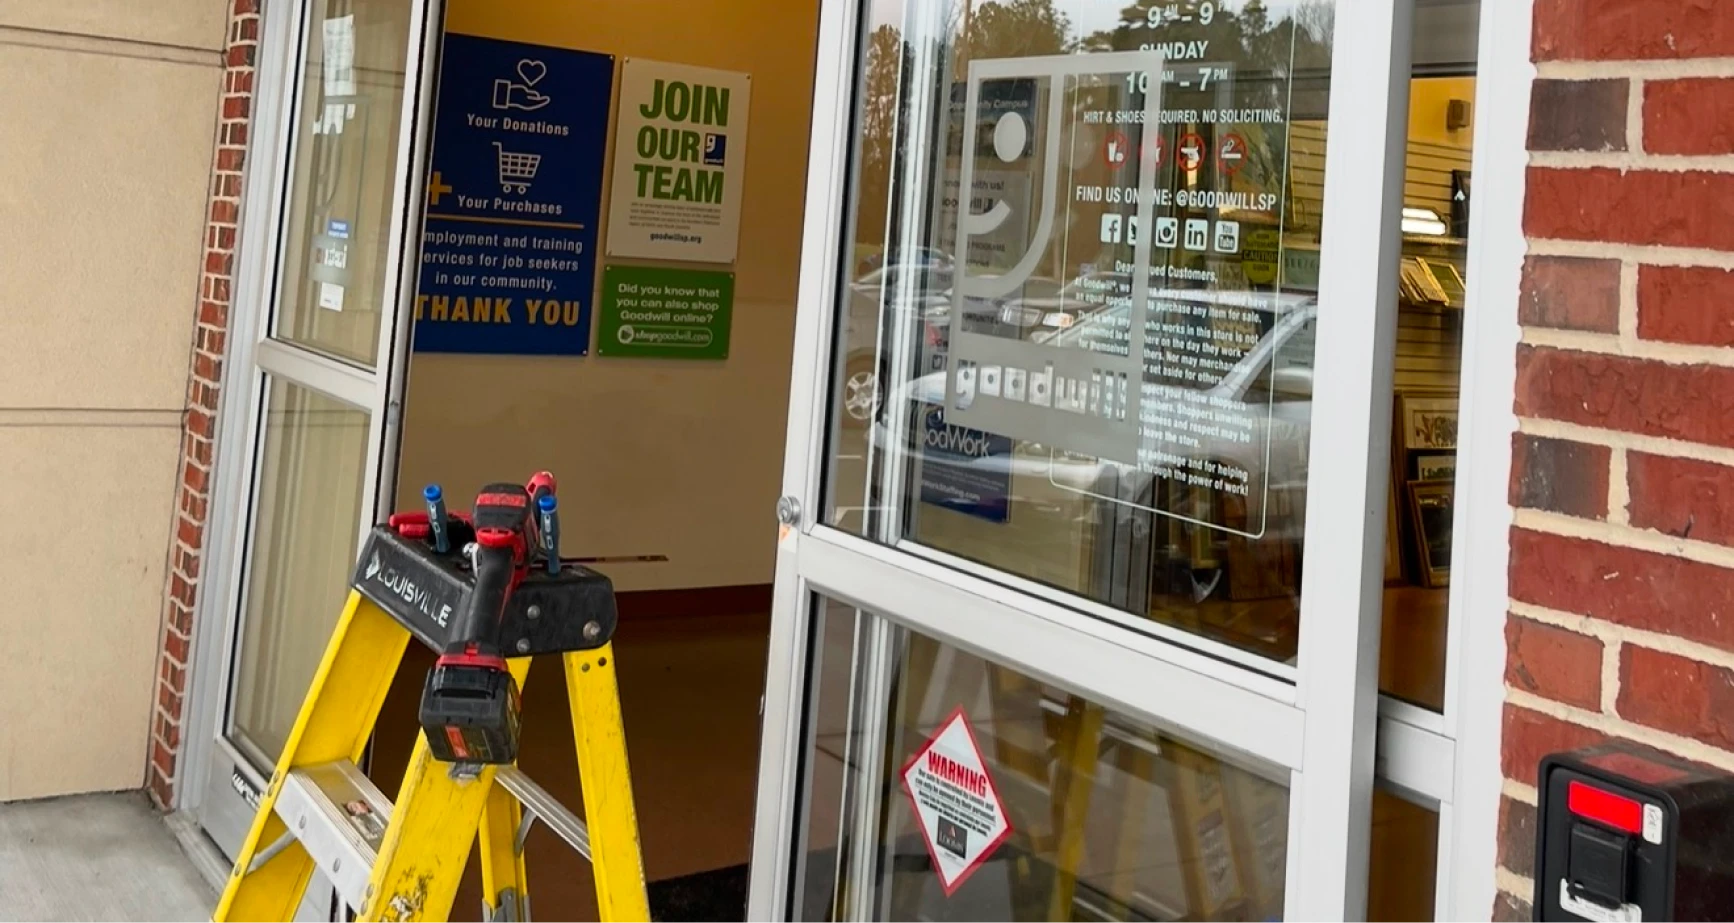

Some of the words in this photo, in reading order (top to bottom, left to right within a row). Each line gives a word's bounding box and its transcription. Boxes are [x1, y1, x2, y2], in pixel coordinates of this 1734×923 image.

[1148, 6, 1161, 28] 9
[1200, 2, 1214, 26] 9
[1198, 68, 1212, 91] 7
[1214, 68, 1228, 80] PM
[640, 79, 730, 126] JOIN
[466, 114, 498, 129] Your
[502, 117, 570, 136] Donations
[1084, 110, 1104, 124] HIRT
[1106, 111, 1112, 123] &
[1116, 110, 1145, 124] SHOES
[1158, 110, 1200, 124] QUIRED.
[1202, 110, 1217, 123] NO
[1220, 109, 1283, 124] SOLICITING.
[637, 126, 700, 162] OUR
[634, 164, 724, 204] TEAM
[458, 195, 488, 210] Your
[494, 198, 562, 215] Purchases
[1076, 186, 1102, 202] FIND
[1106, 187, 1121, 204] US
[1124, 188, 1172, 206] ONNE:
[1176, 190, 1276, 210] @GOODWILLSP
[424, 232, 498, 248] mployment
[504, 236, 528, 248] and
[532, 236, 583, 254] training
[650, 232, 702, 244] goodwillsp.org
[424, 252, 474, 266] ervices
[479, 254, 498, 268] for
[502, 254, 524, 270] job
[528, 256, 578, 271] seekers
[1115, 260, 1134, 273] Dear
[1168, 265, 1218, 284] Customers,
[436, 270, 448, 284] in
[454, 274, 476, 286] our
[481, 275, 557, 292] community.
[618, 284, 638, 293] Did
[640, 286, 662, 296] you
[665, 286, 695, 296] know
[698, 288, 720, 298] that
[416, 295, 512, 323] THANK
[526, 300, 580, 326] YOU
[616, 298, 638, 308] you
[641, 300, 662, 308] can
[665, 300, 688, 309] also
[692, 301, 720, 312] shop
[1156, 301, 1190, 316] purchase
[1192, 306, 1207, 318] any
[1209, 306, 1226, 318] item
[1228, 308, 1240, 320] for
[1242, 311, 1262, 324] sale.
[620, 310, 670, 321] Goodwill
[674, 312, 713, 323] online?
[636, 330, 710, 342] shopgoodwill.com
[1162, 322, 1185, 334] works
[1186, 324, 1194, 335] in
[1196, 326, 1211, 338] this
[1213, 328, 1233, 342] store
[1235, 332, 1243, 342] is
[1245, 332, 1259, 344] not
[1144, 348, 1164, 360] thers.
[1181, 354, 1198, 368] may
[1162, 337, 1170, 347] on
[1172, 338, 1185, 348] the
[1186, 340, 1200, 352] day
[1202, 342, 1219, 356] they
[1222, 345, 1241, 357] work
[1163, 367, 1182, 378] aside
[1185, 368, 1196, 380] for
[1210, 396, 1246, 411] shoppers
[924, 423, 990, 458] odWork
[1174, 419, 1188, 430] and
[1190, 423, 1220, 436] respect
[1221, 430, 1236, 442] may
[1240, 432, 1250, 443] be
[1188, 458, 1202, 470] and
[1205, 460, 1216, 472] for
[1218, 463, 1248, 482] helping
[1174, 470, 1186, 482] the
[1188, 474, 1213, 488] power
[1214, 478, 1223, 490] of
[1224, 482, 1248, 496] work!
[377, 560, 452, 628] LOUISVILLE
[928, 750, 986, 798] WARNING
